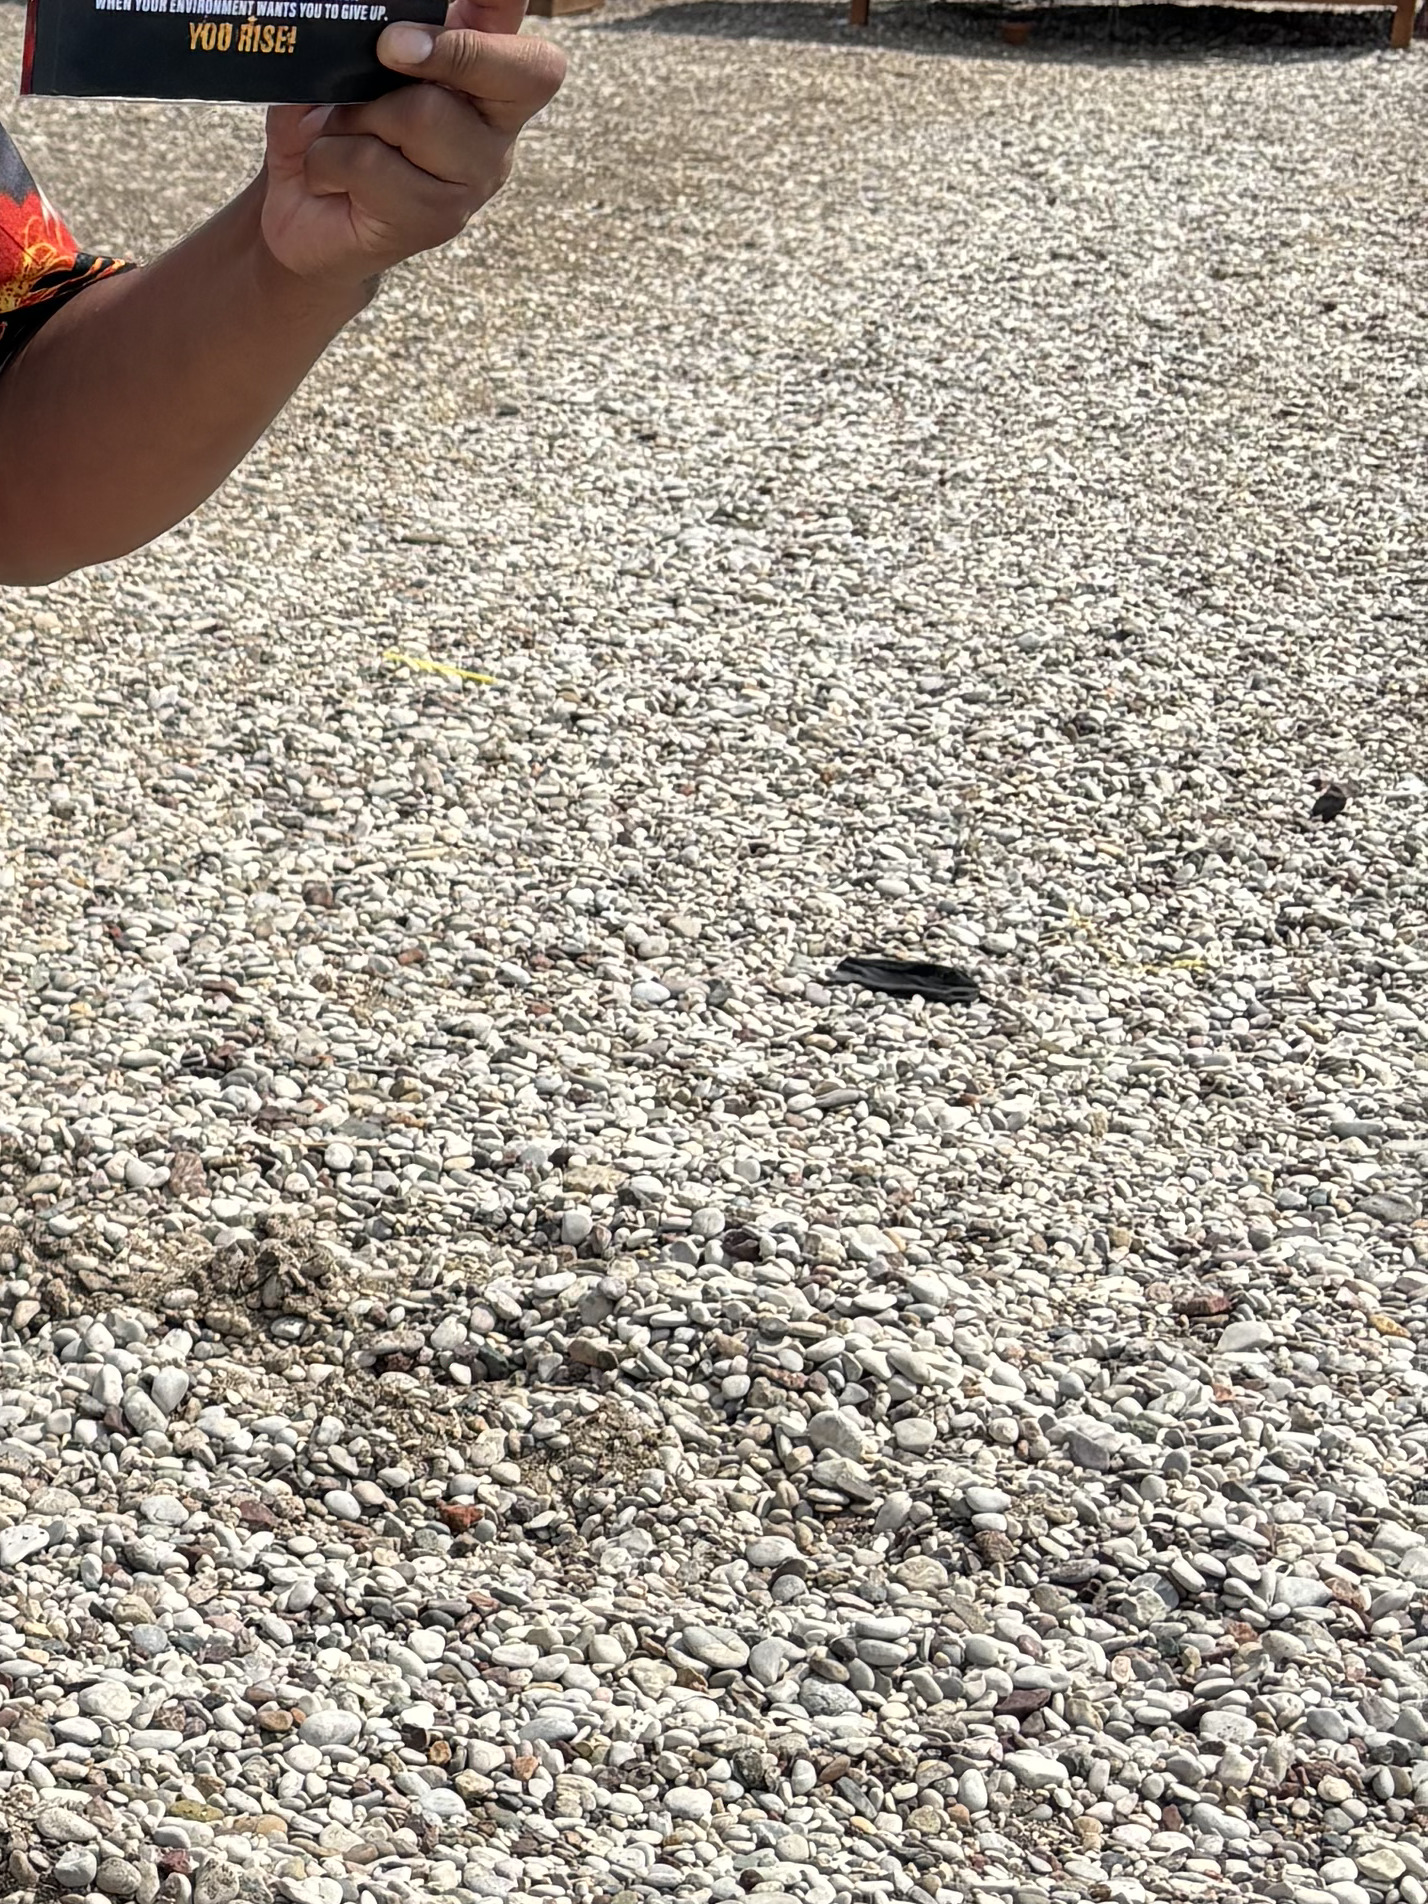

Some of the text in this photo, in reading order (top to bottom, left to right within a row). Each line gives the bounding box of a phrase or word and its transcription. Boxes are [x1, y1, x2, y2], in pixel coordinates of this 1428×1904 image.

[256, 1, 298, 18] WANTS
[299, 3, 323, 19] YOU
[324, 4, 340, 20] TO
[341, 4, 370, 21] GIVE
[369, 5, 389, 22] UP.
[189, 22, 298, 54] YOU RISE!
